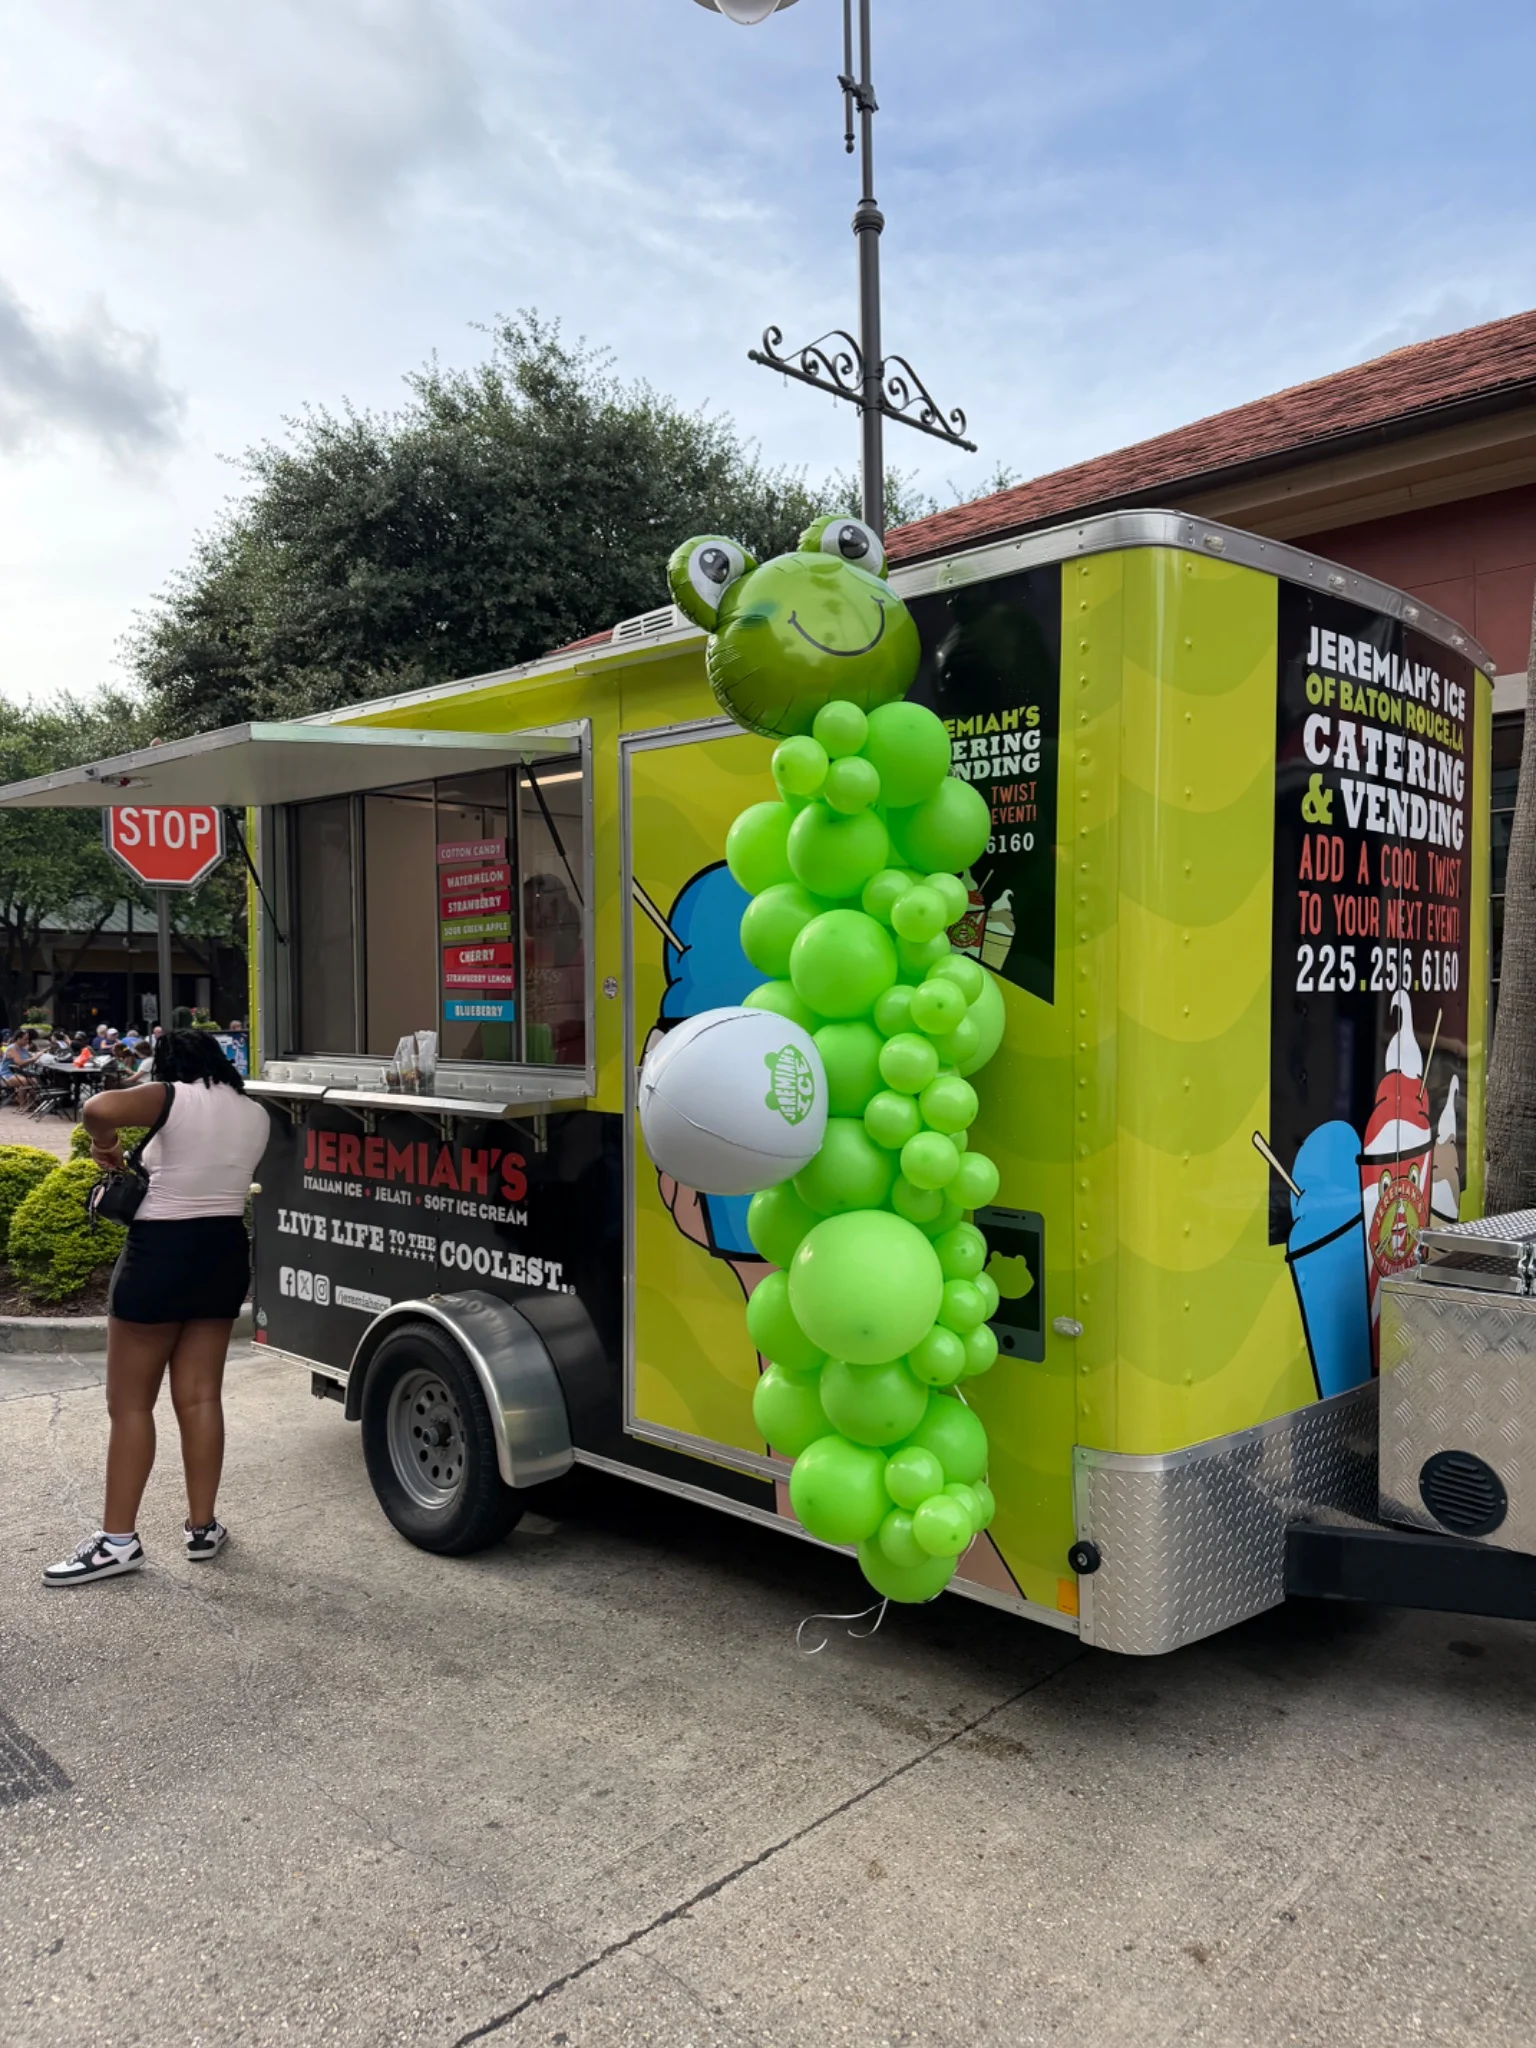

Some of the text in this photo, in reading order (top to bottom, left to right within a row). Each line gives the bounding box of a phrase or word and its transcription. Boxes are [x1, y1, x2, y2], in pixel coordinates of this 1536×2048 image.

[1306, 626, 1465, 722] JEREMIAH'S ICE
[1305, 672, 1336, 707] OF
[1340, 679, 1402, 727] BATON
[943, 705, 1040, 739] EMIAH'S
[953, 729, 1041, 761] ERING
[1302, 713, 1465, 802] CATERING
[953, 752, 1041, 781] NDING
[990, 781, 1037, 805] TWIST
[991, 804, 1037, 825] EVENT!
[1301, 772, 1464, 851] & VENDING
[119, 807, 211, 850] STOP
[986, 831, 1035, 855] 6160
[441, 844, 501, 859] COTTON CANDY
[1299, 833, 1462, 899] ADD A COOL TWIST
[446, 870, 504, 888] WATERMELON
[448, 895, 501, 913] STRAWBERRY
[1298, 890, 1461, 944] TO YOUR NEXT EVENT!
[485, 922, 507, 932] APPLE
[459, 948, 495, 963] CHERRY
[1295, 944, 1459, 993] 225.256.6160
[446, 973, 512, 984] STRAWBERRY LEMON
[454, 1005, 504, 1017] BLUEBERRY
[303, 1129, 528, 1202] JEREMIAH'S
[303, 1175, 528, 1226] ITALIAN ICE JELATI SOFT ICE CREAM
[277, 1208, 327, 1241] LIVE
[331, 1220, 384, 1253] LIFE
[388, 1228, 406, 1246] TO
[408, 1232, 437, 1251] THE
